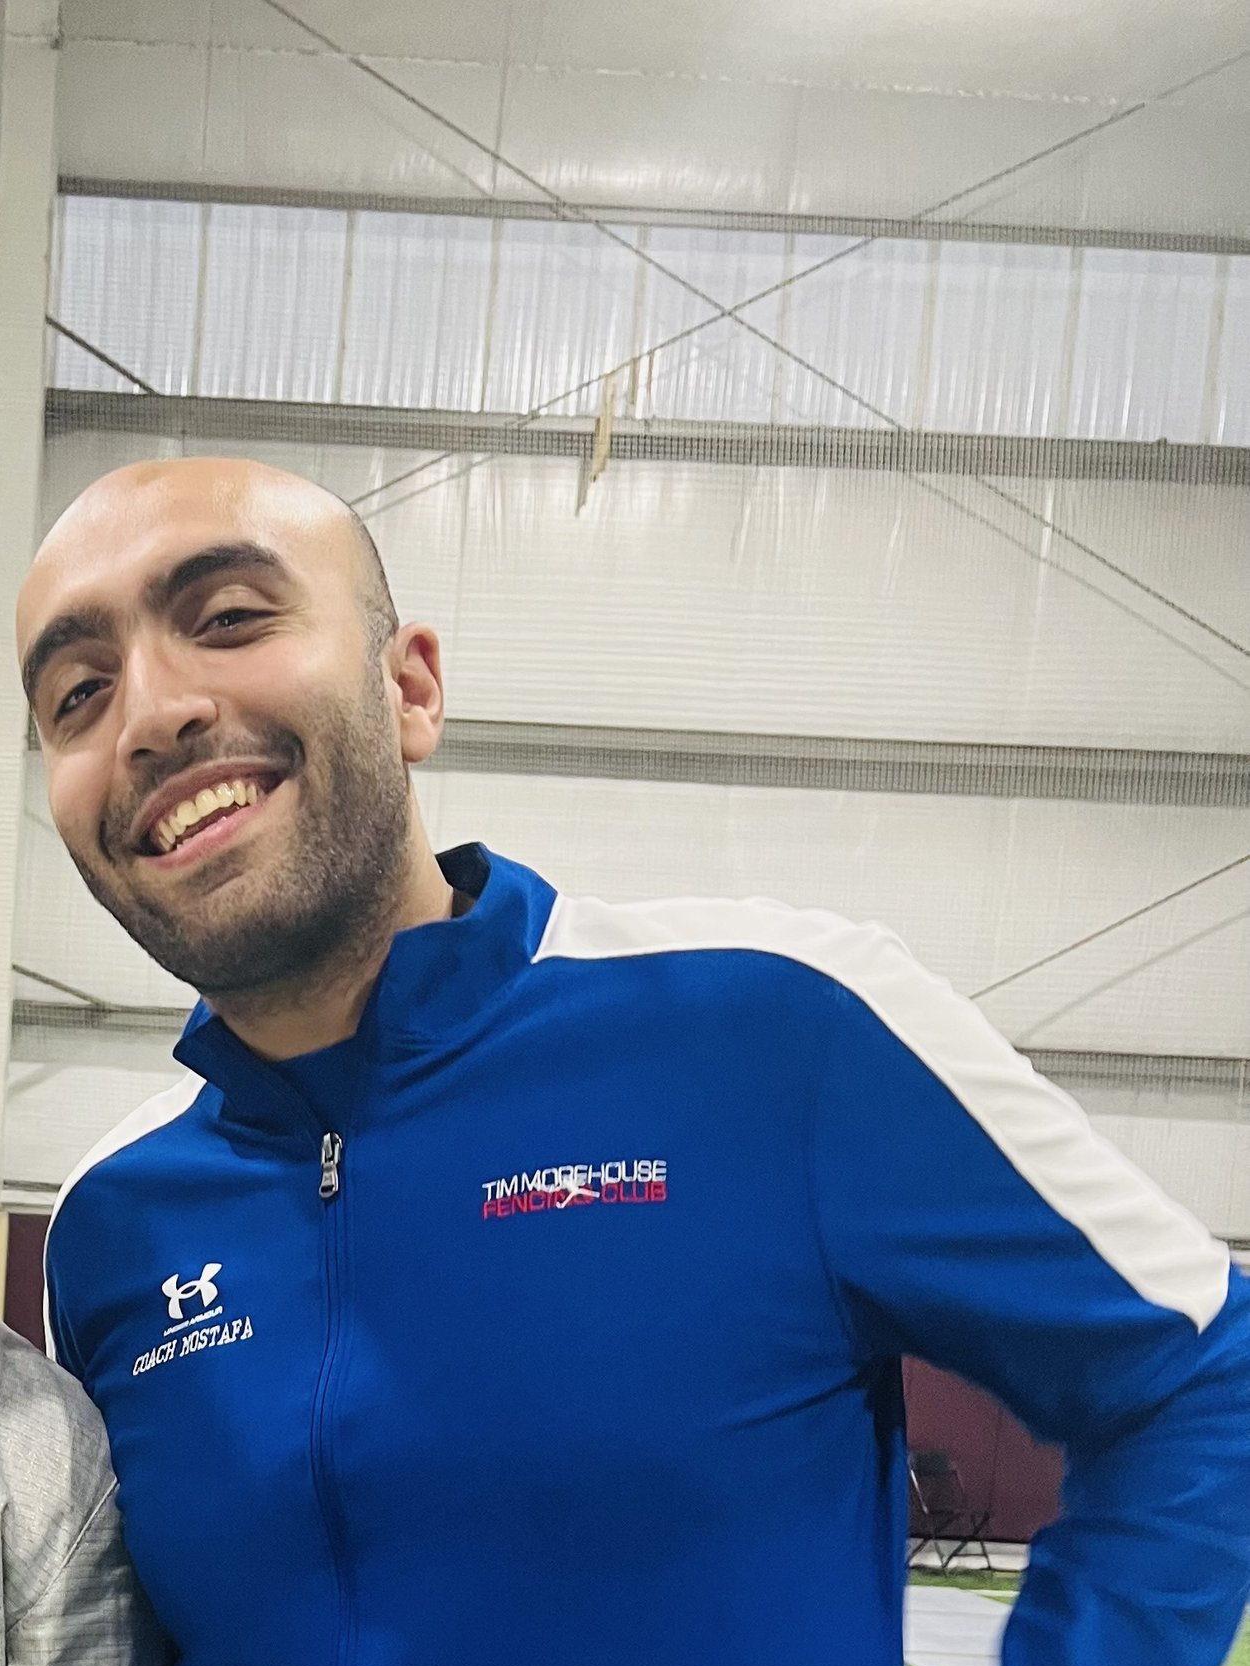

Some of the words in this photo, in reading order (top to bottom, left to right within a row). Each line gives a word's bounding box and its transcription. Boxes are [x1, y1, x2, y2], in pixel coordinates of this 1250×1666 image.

[482, 1174, 518, 1201] TIM
[521, 1160, 667, 1193] MOREHOUSE
[483, 1184, 594, 1220] FENCING
[602, 1181, 667, 1204] CLUB
[132, 1340, 177, 1376] COACH
[179, 1316, 253, 1357] MOSTAFA
